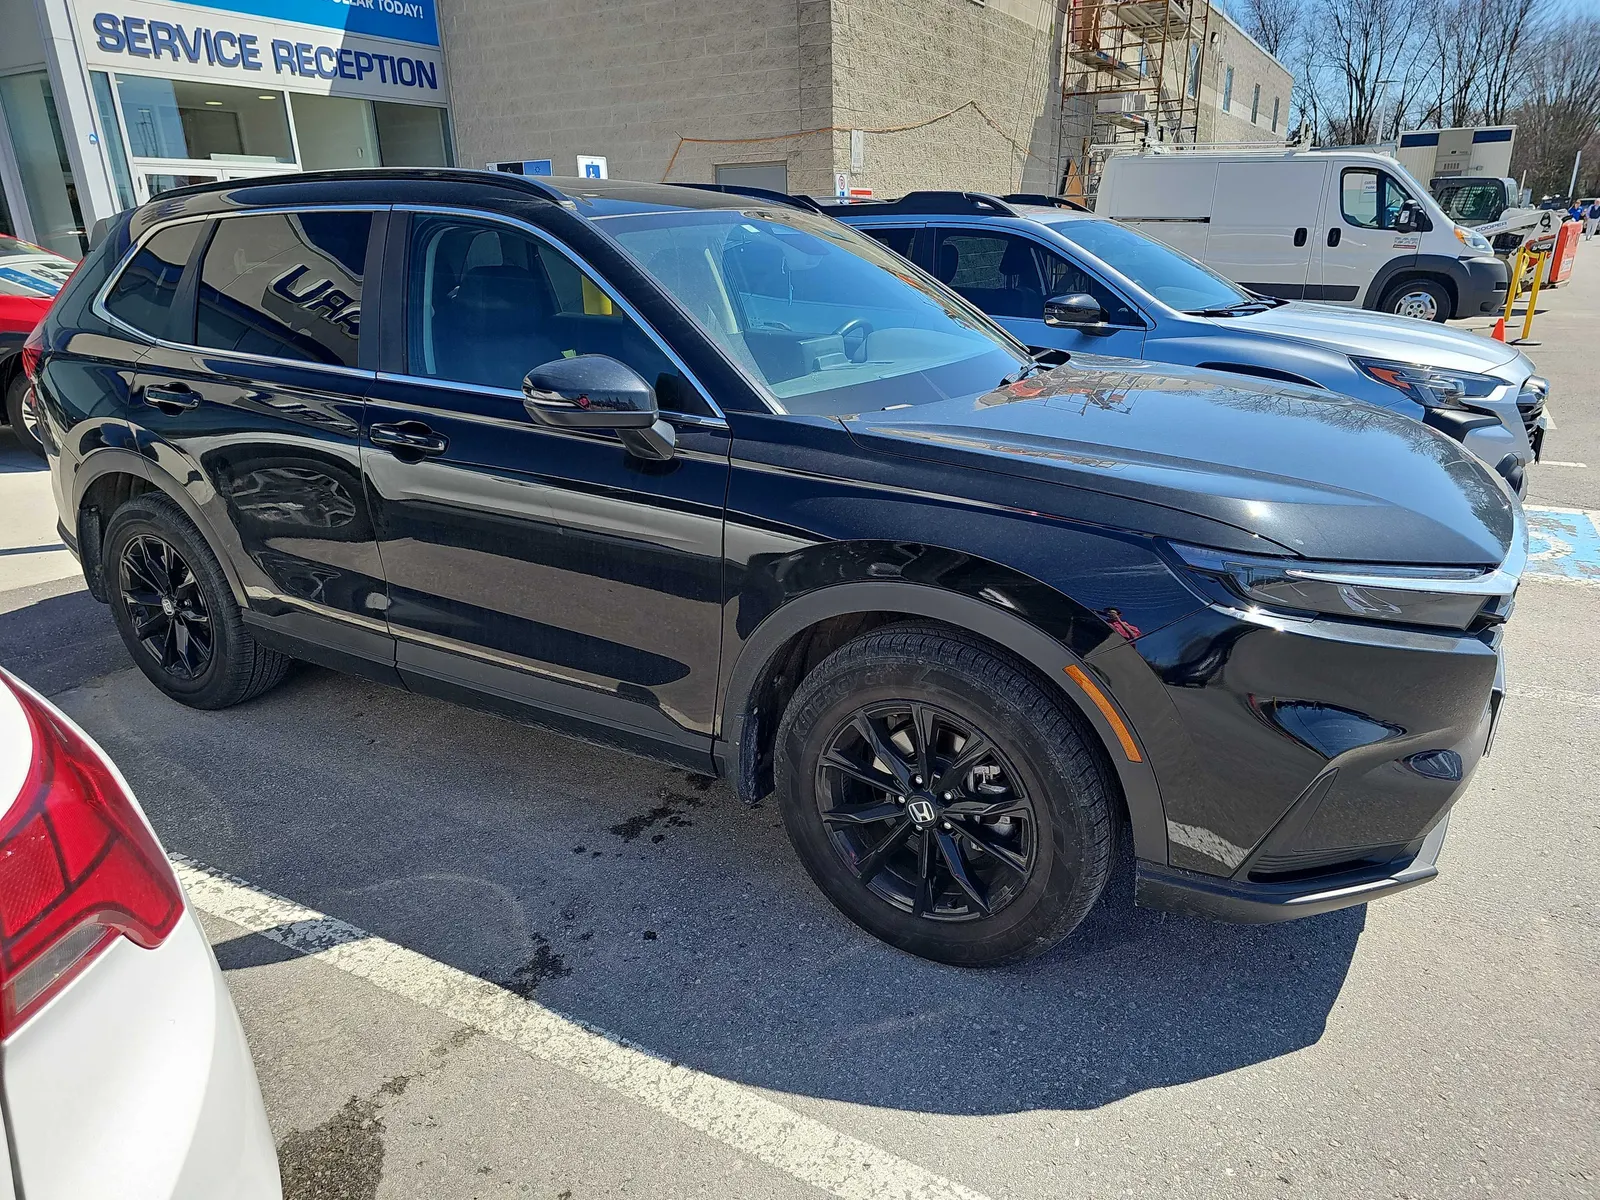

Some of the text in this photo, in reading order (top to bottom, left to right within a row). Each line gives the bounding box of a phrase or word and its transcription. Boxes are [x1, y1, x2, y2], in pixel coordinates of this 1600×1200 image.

[377, 0, 424, 19] TODAY!
[93, 12, 438, 90] SERVICE RECEPTION
[1475, 221, 1508, 232] COOPER
